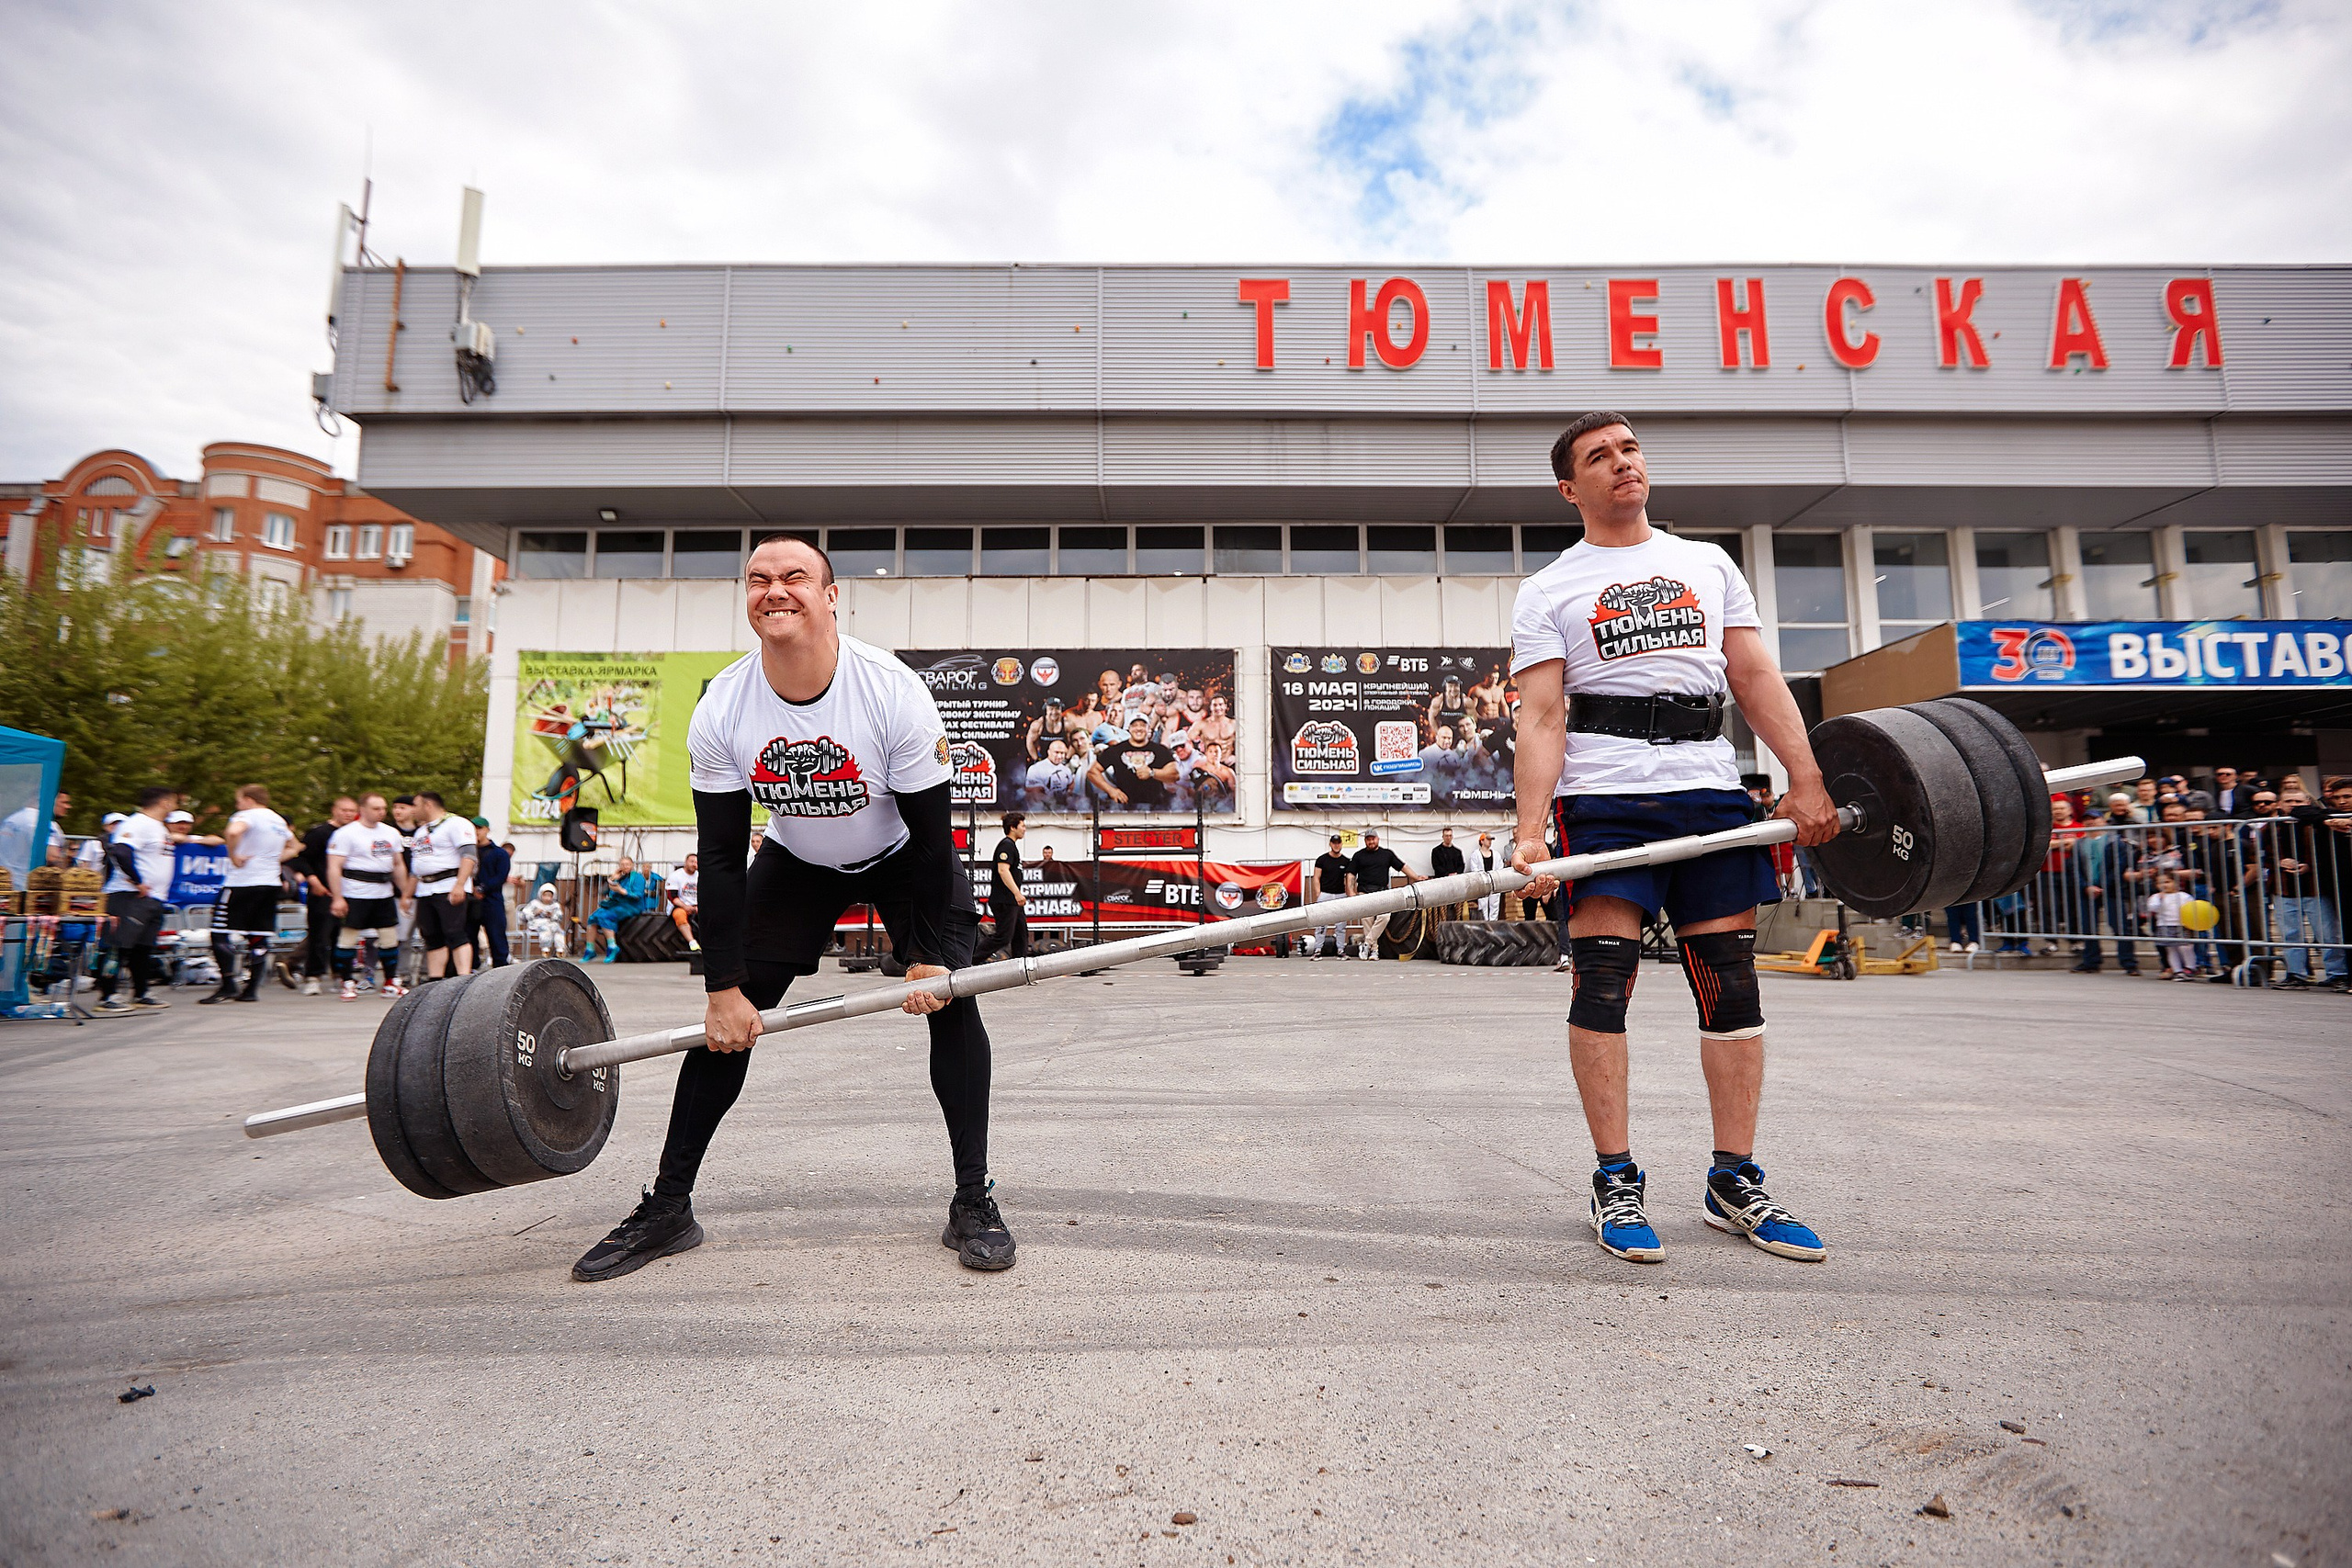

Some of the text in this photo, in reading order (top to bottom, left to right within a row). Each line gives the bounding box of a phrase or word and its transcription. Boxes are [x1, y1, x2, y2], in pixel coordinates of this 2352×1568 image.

[1238, 277, 2223, 370] ТЮМЕНСКАЯ
[1594, 606, 1703, 639] ТЮМЕНЬ
[1600, 627, 1704, 660] СИЛЬНАЯ
[1400, 657, 1429, 672] ВТБ
[1283, 682, 1358, 696] 18 МАЯ
[1363, 682, 1430, 691] КРУПНЕЙШИЙ
[972, 700, 1009, 709] ТУРНИР
[1307, 699, 1358, 712] 2024
[972, 710, 1021, 719] ЭКСТРИМУ
[959, 720, 1015, 729] ФЕСТИВАЛЯ
[1296, 747, 1355, 759] ТЮМЕНЬ
[1296, 760, 1355, 770] СИЛЬНАЯ
[753, 780, 865, 799] ТЮМЕНЬ
[520, 798, 560, 819] 2024
[1114, 832, 1182, 845] STECTER
[1893, 824, 1914, 850] 50
[1893, 844, 1909, 861] KG
[516, 1030, 537, 1055] 50
[517, 1052, 533, 1067] KG
[593, 1079, 605, 1093] KG
